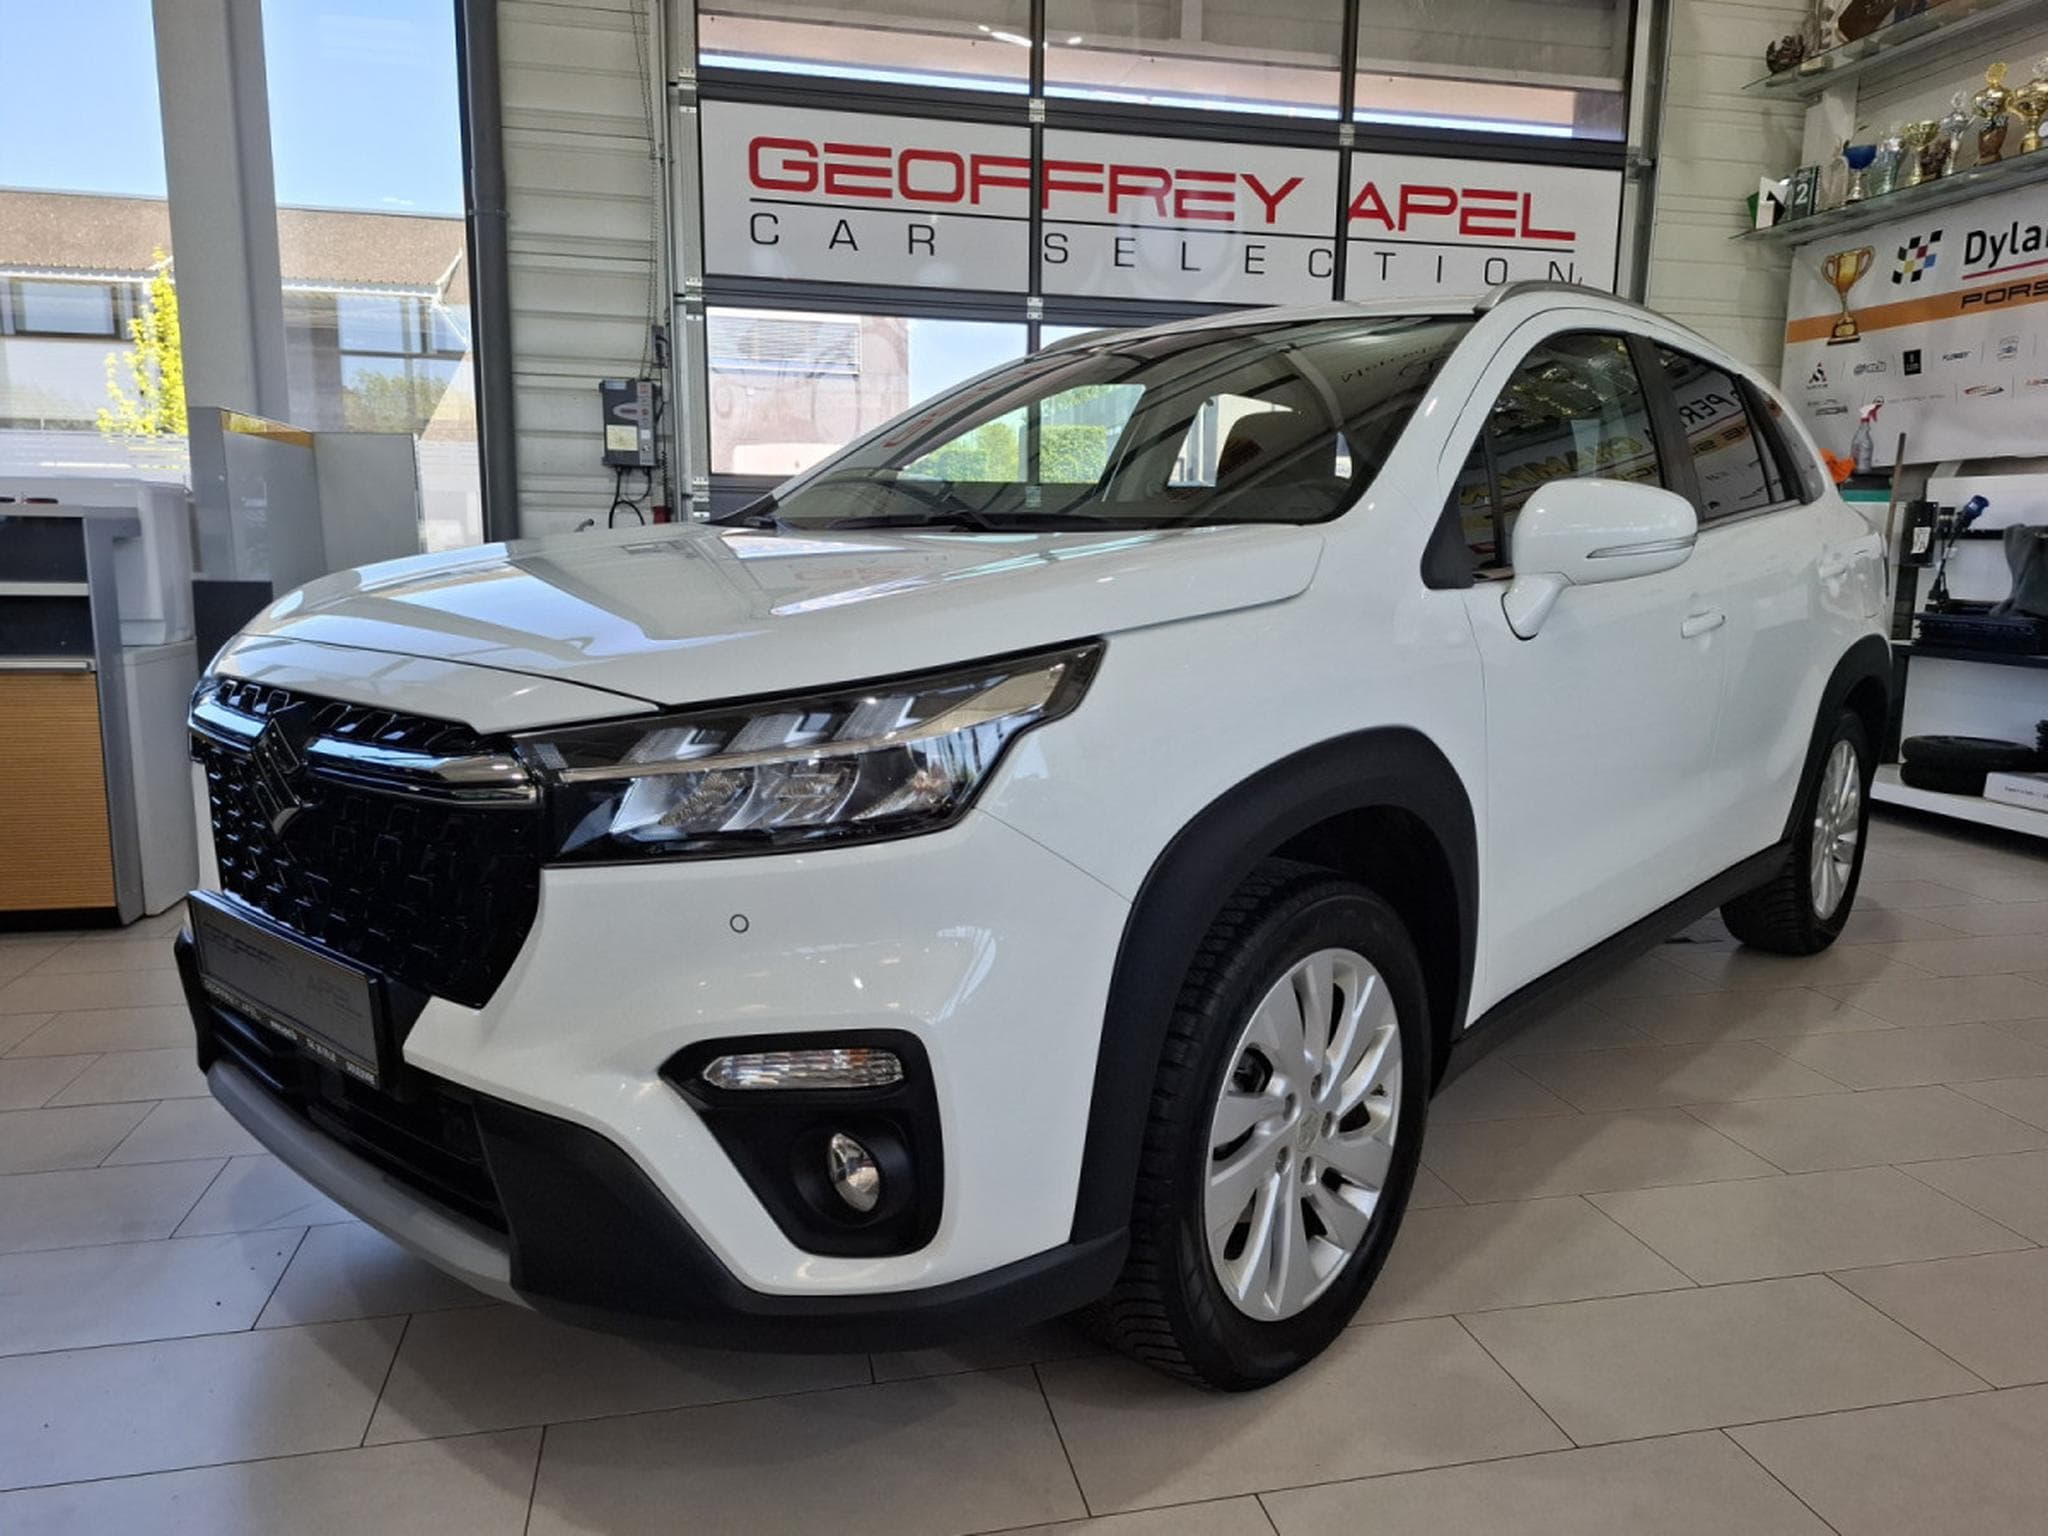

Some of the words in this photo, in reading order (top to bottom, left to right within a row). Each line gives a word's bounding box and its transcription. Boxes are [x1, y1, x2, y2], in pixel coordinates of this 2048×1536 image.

[748, 136, 1305, 224] GEOFFREY
[1348, 181, 1576, 241] APEL
[1794, 183, 1809, 205] 2
[749, 212, 936, 256] CAR
[1043, 232, 1575, 286] SELECTION
[1964, 221, 2048, 268] Dyla
